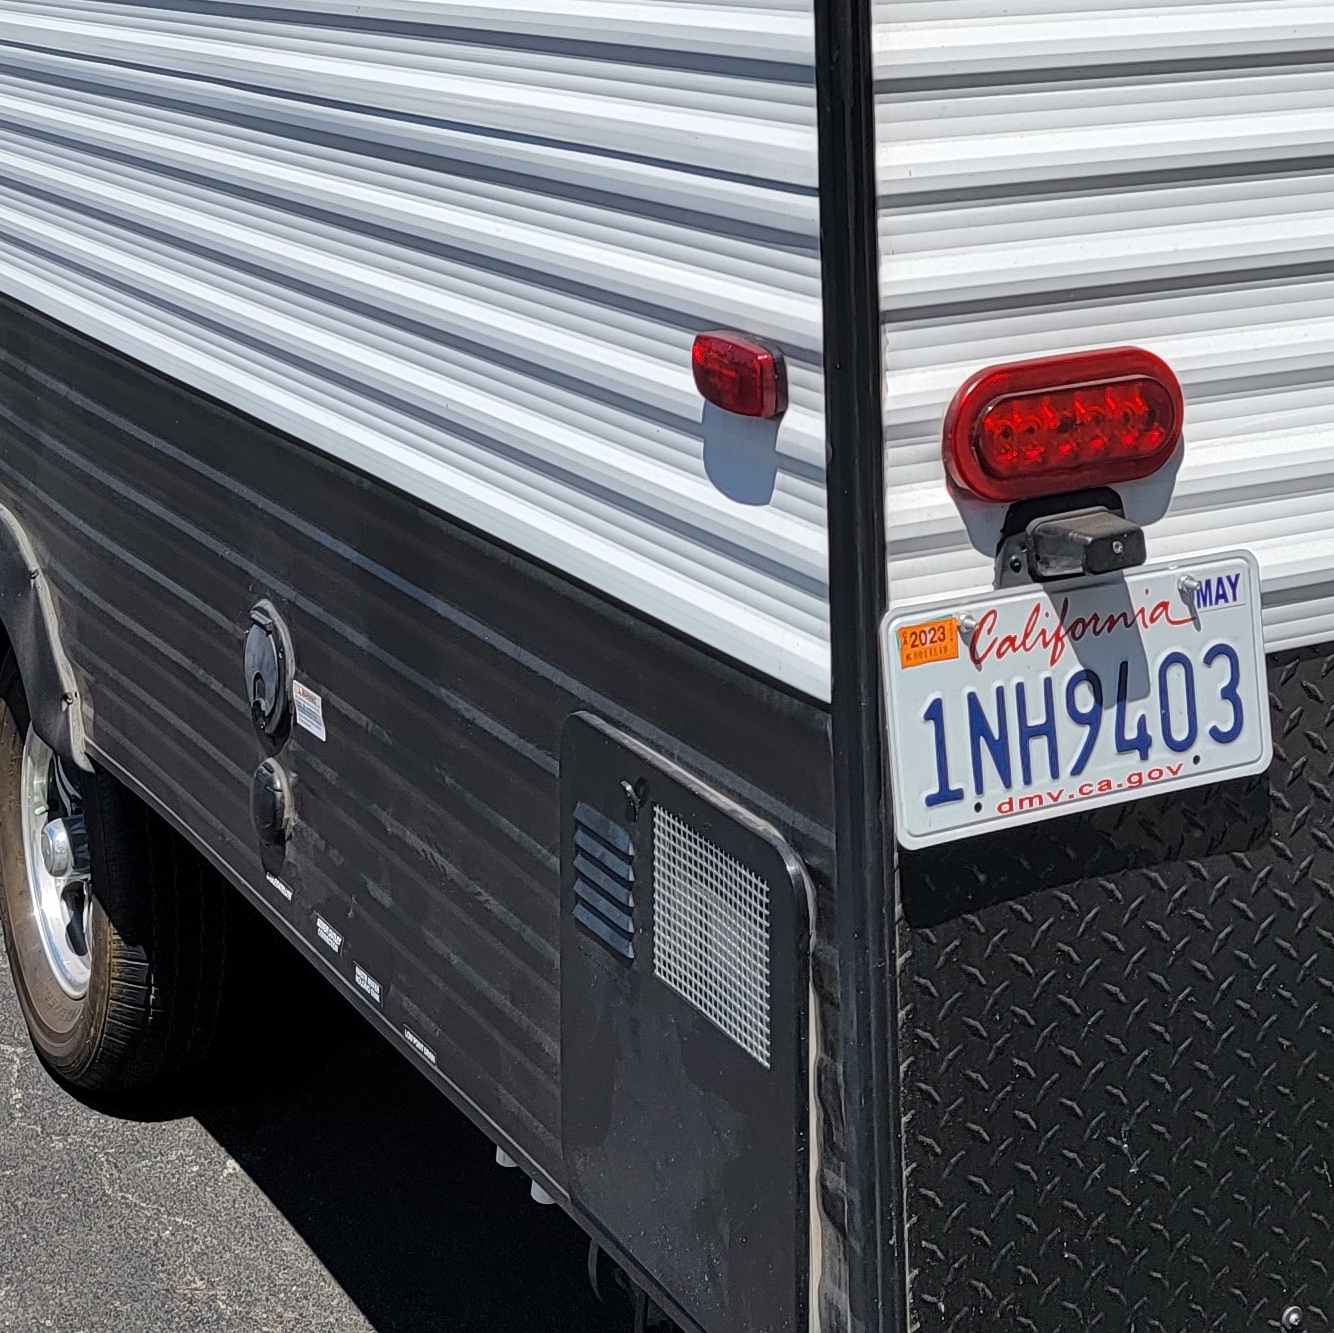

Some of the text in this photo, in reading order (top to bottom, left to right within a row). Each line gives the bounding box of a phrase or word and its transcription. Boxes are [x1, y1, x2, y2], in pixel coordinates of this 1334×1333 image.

[1195, 573, 1241, 609] MAY
[909, 624, 947, 649] 2023
[968, 588, 1196, 667] California
[924, 643, 1243, 807] 1NH9403
[996, 762, 1184, 815] dmv.ca.gov
